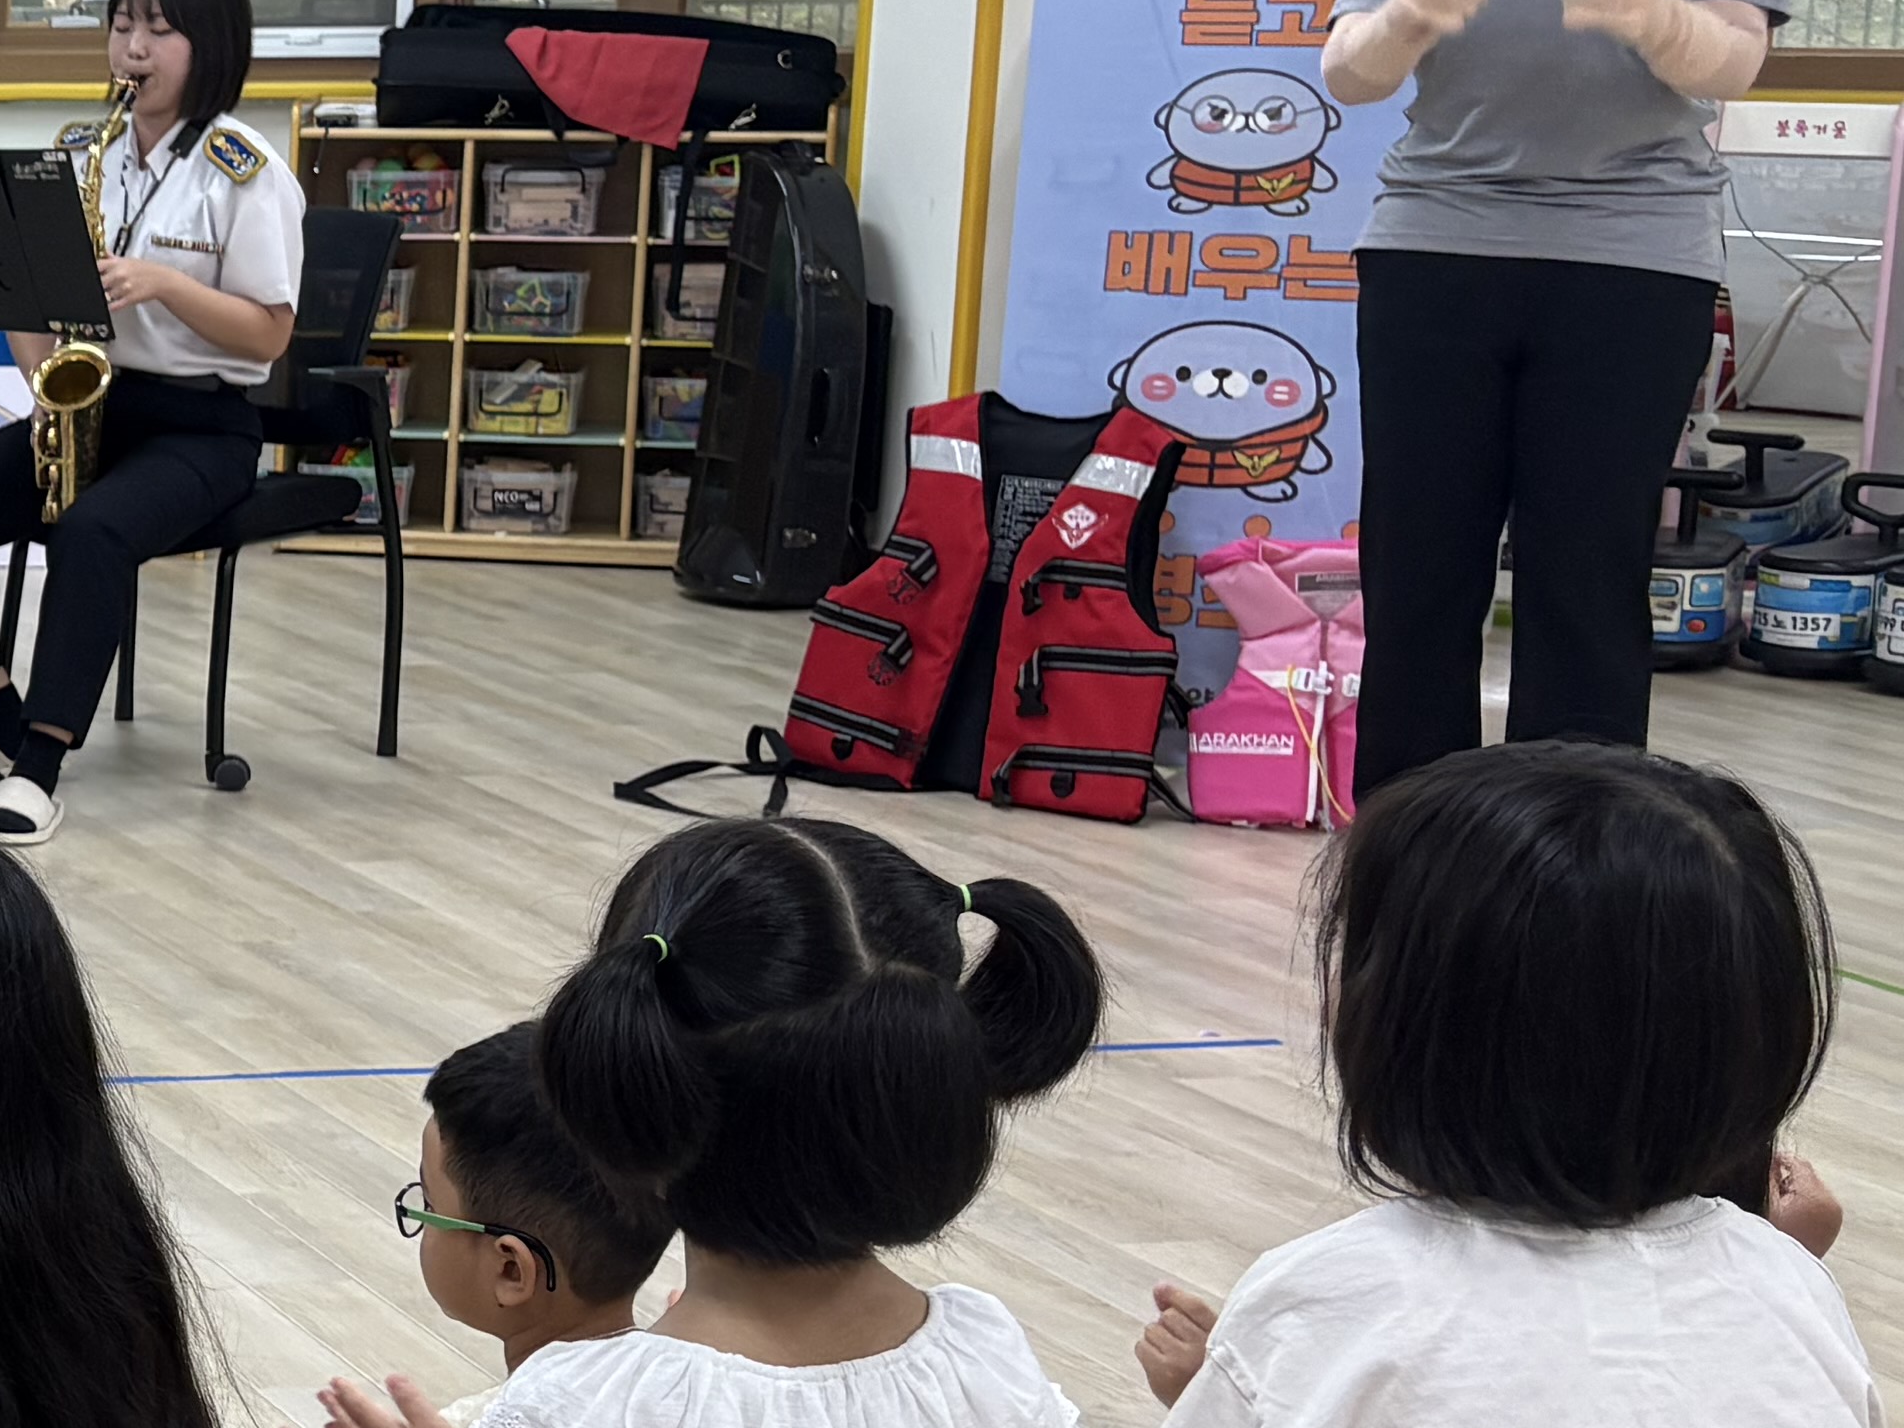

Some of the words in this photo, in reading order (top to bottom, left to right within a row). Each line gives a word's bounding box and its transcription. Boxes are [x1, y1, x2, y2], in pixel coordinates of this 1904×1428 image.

[1103, 230, 1359, 302] 배우는
[1791, 615, 1832, 633] 1357
[1198, 731, 1295, 750] ARAKHAN
